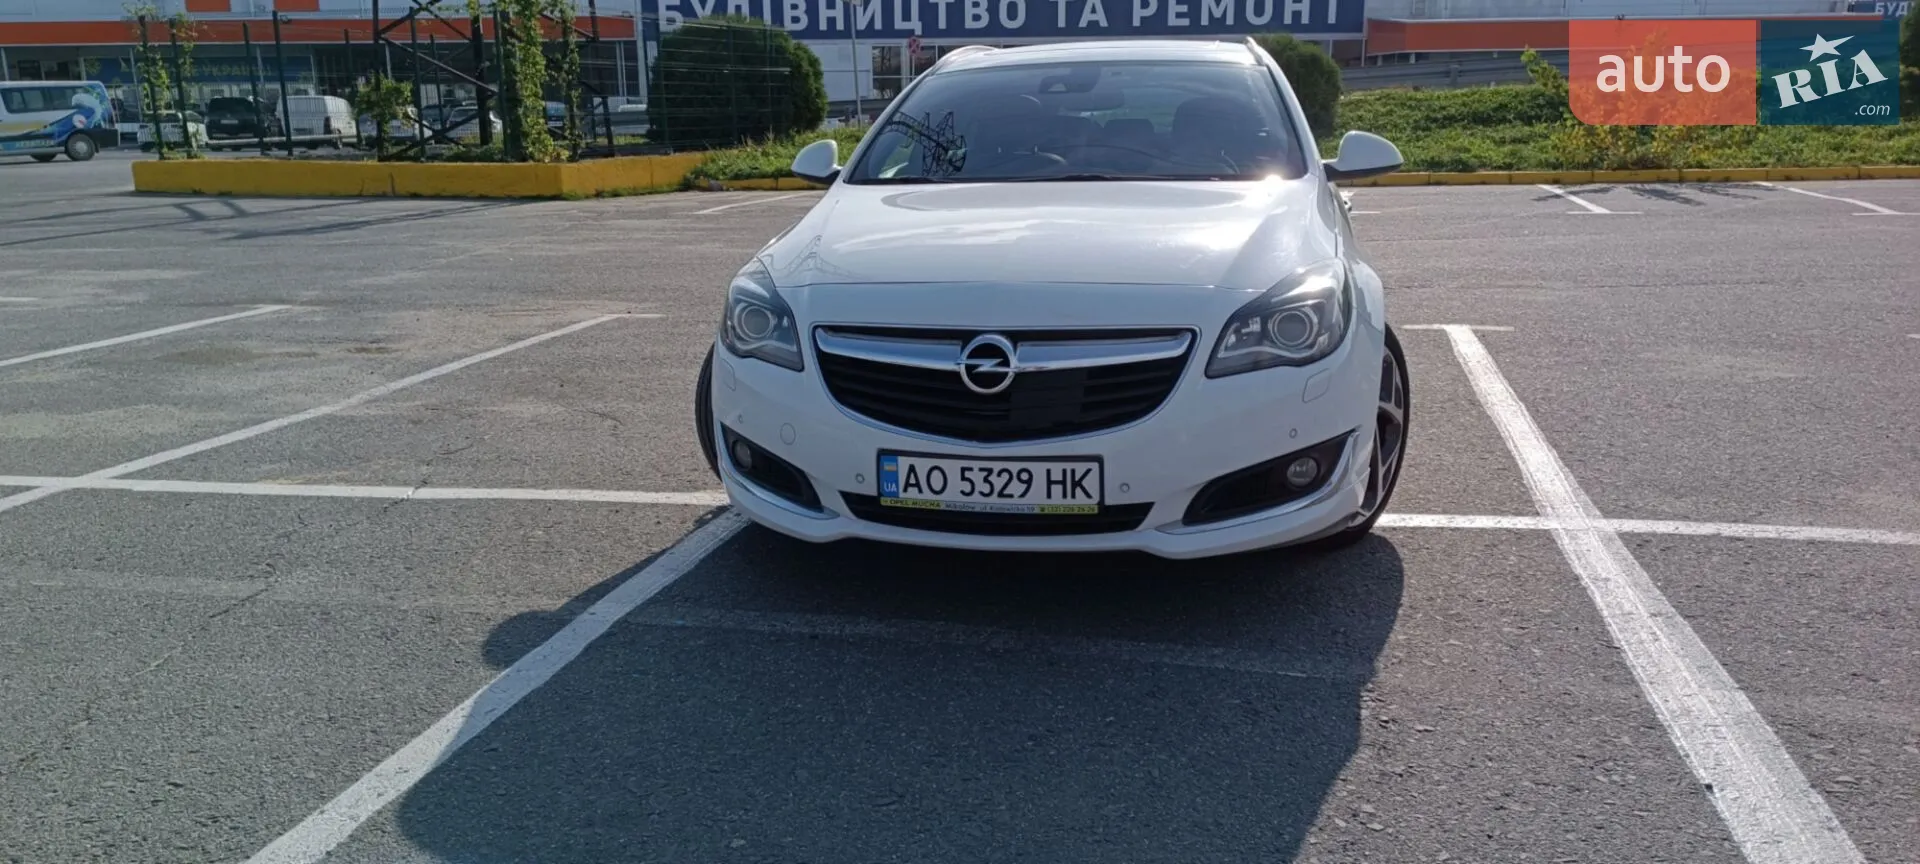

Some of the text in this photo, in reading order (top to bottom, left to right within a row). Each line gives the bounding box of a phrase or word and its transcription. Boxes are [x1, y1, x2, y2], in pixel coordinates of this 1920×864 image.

[1050, 0, 1109, 28] ТА
[883, 482, 898, 492] UA
[903, 464, 1093, 499] AO 5329 HK
